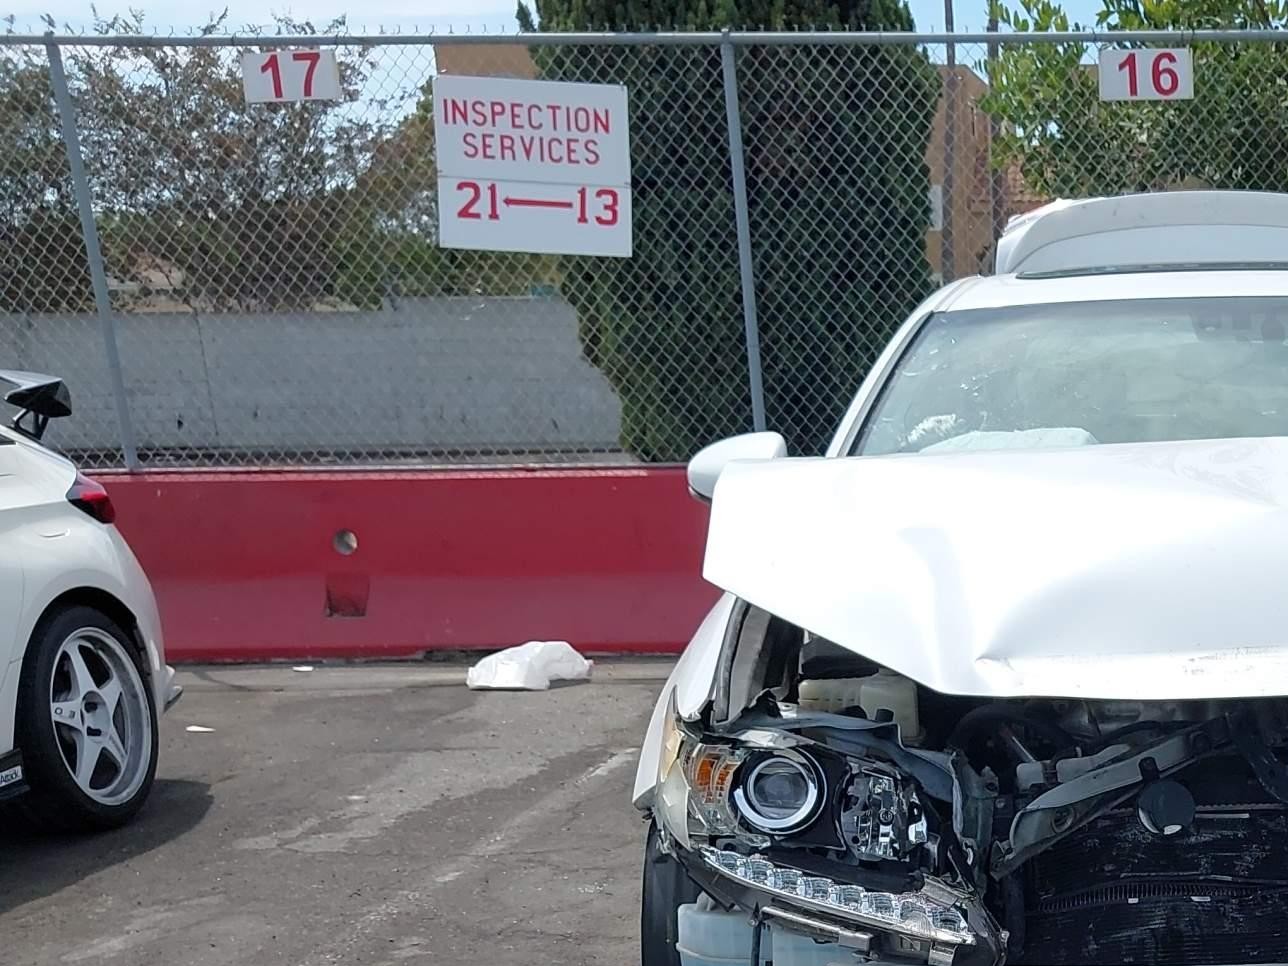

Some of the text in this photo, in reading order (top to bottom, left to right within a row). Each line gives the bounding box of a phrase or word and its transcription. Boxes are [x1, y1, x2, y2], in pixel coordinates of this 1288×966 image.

[260, 52, 320, 98] 17
[1119, 52, 1179, 97] 16
[443, 98, 611, 134] INSPECTION
[463, 133, 601, 165] SERVICES
[457, 181, 619, 226] 21 13
